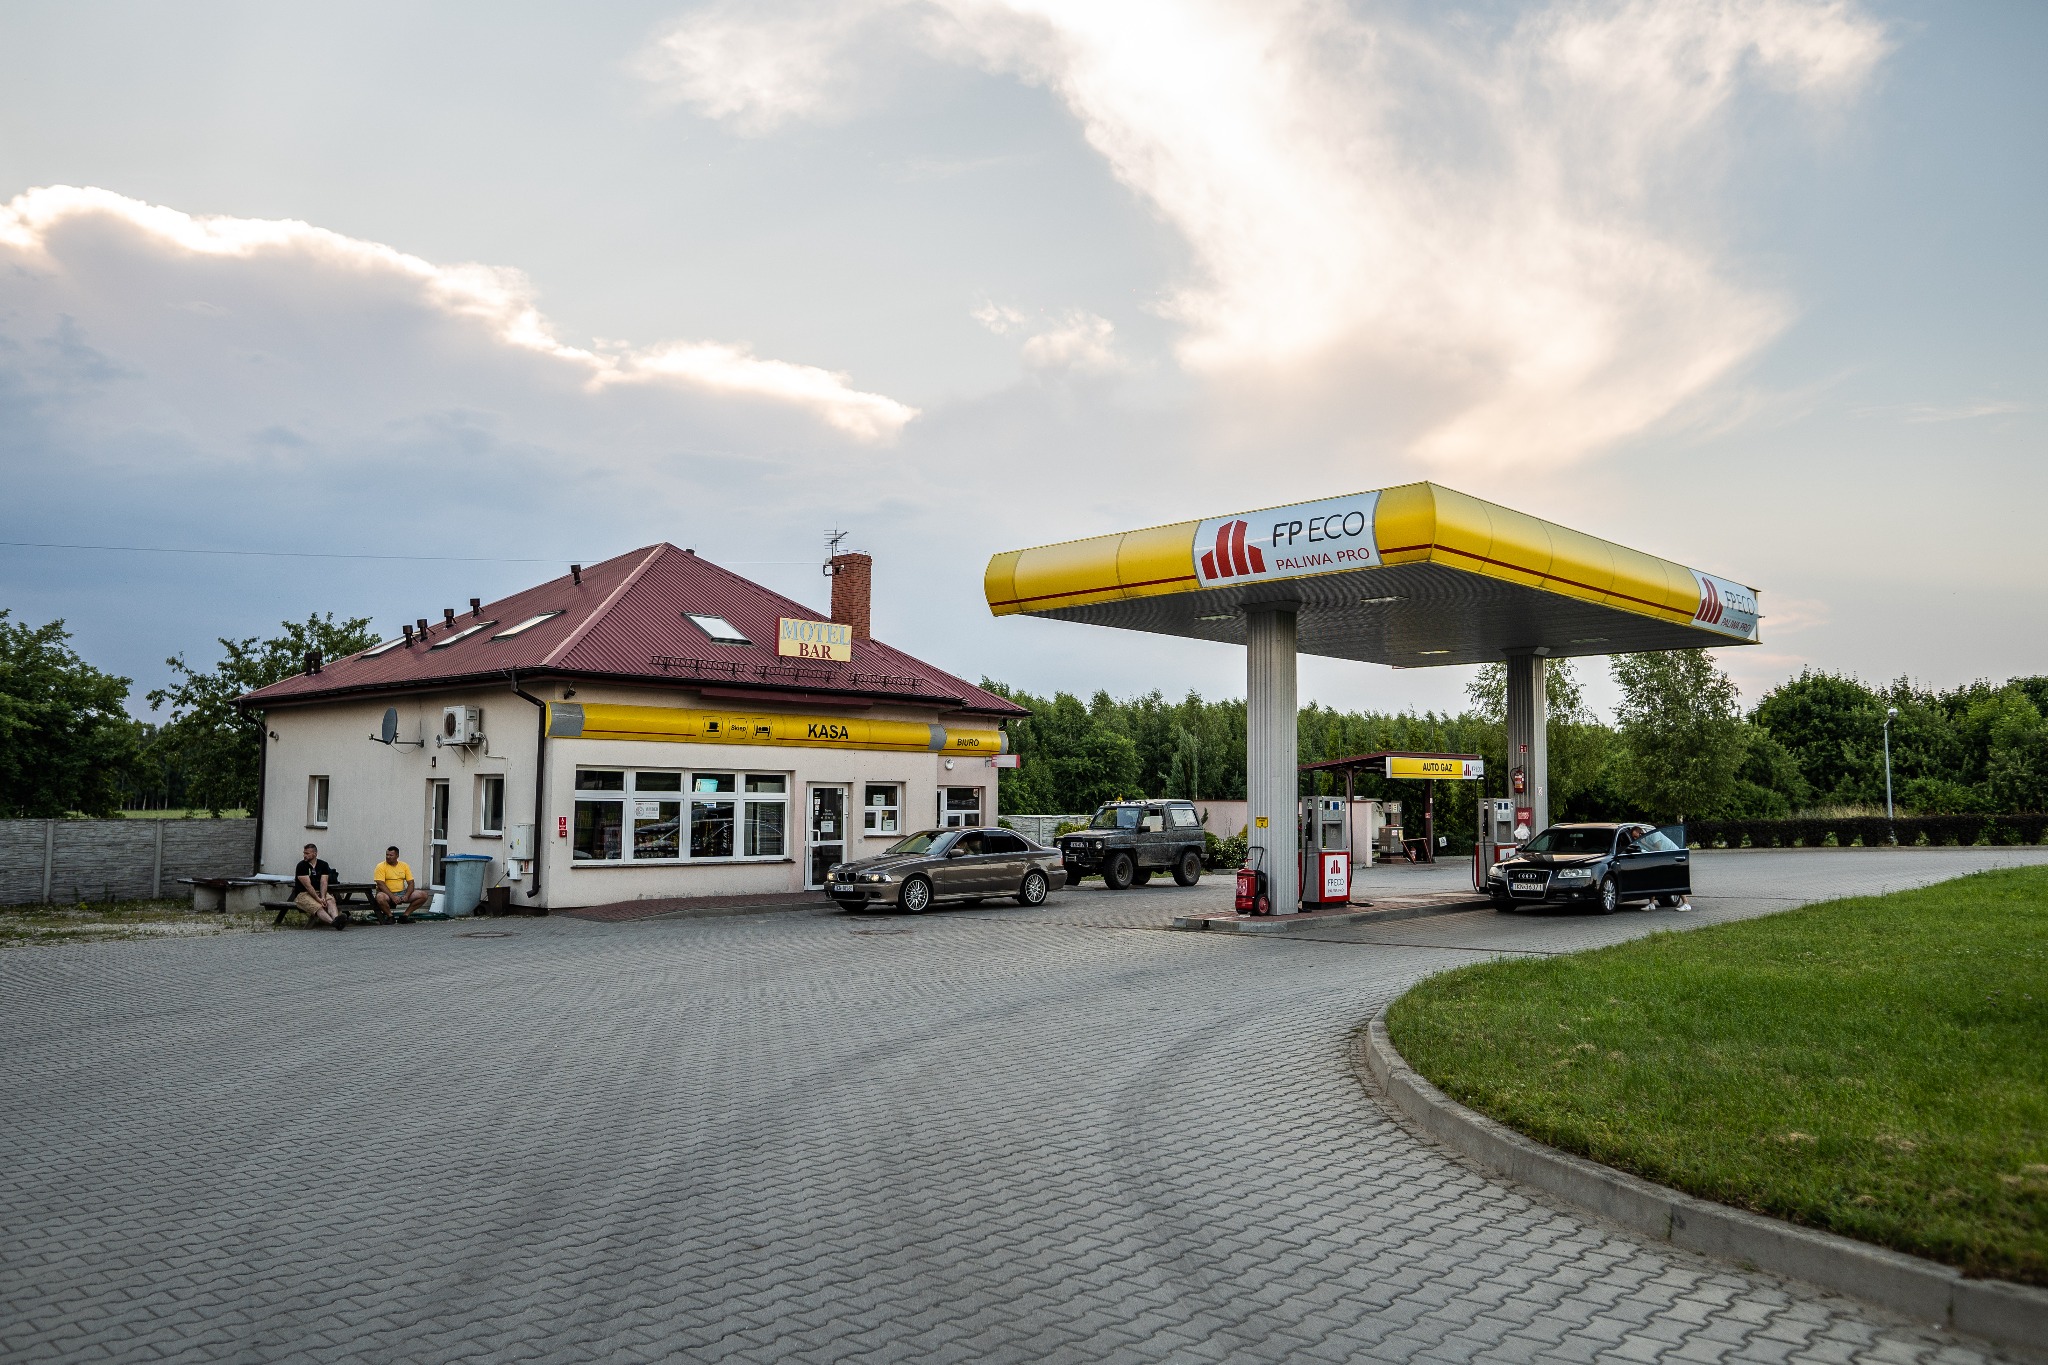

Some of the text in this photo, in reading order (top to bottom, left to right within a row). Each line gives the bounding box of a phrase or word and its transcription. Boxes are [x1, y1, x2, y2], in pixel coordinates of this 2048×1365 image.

[1275, 547, 1370, 570] PALIWA PRO
[780, 619, 850, 646] MOTEL
[798, 642, 833, 659] BAR
[807, 723, 849, 740] KASA
[956, 738, 980, 747] BIURO
[1422, 762, 1453, 772] AUTO GAZ
